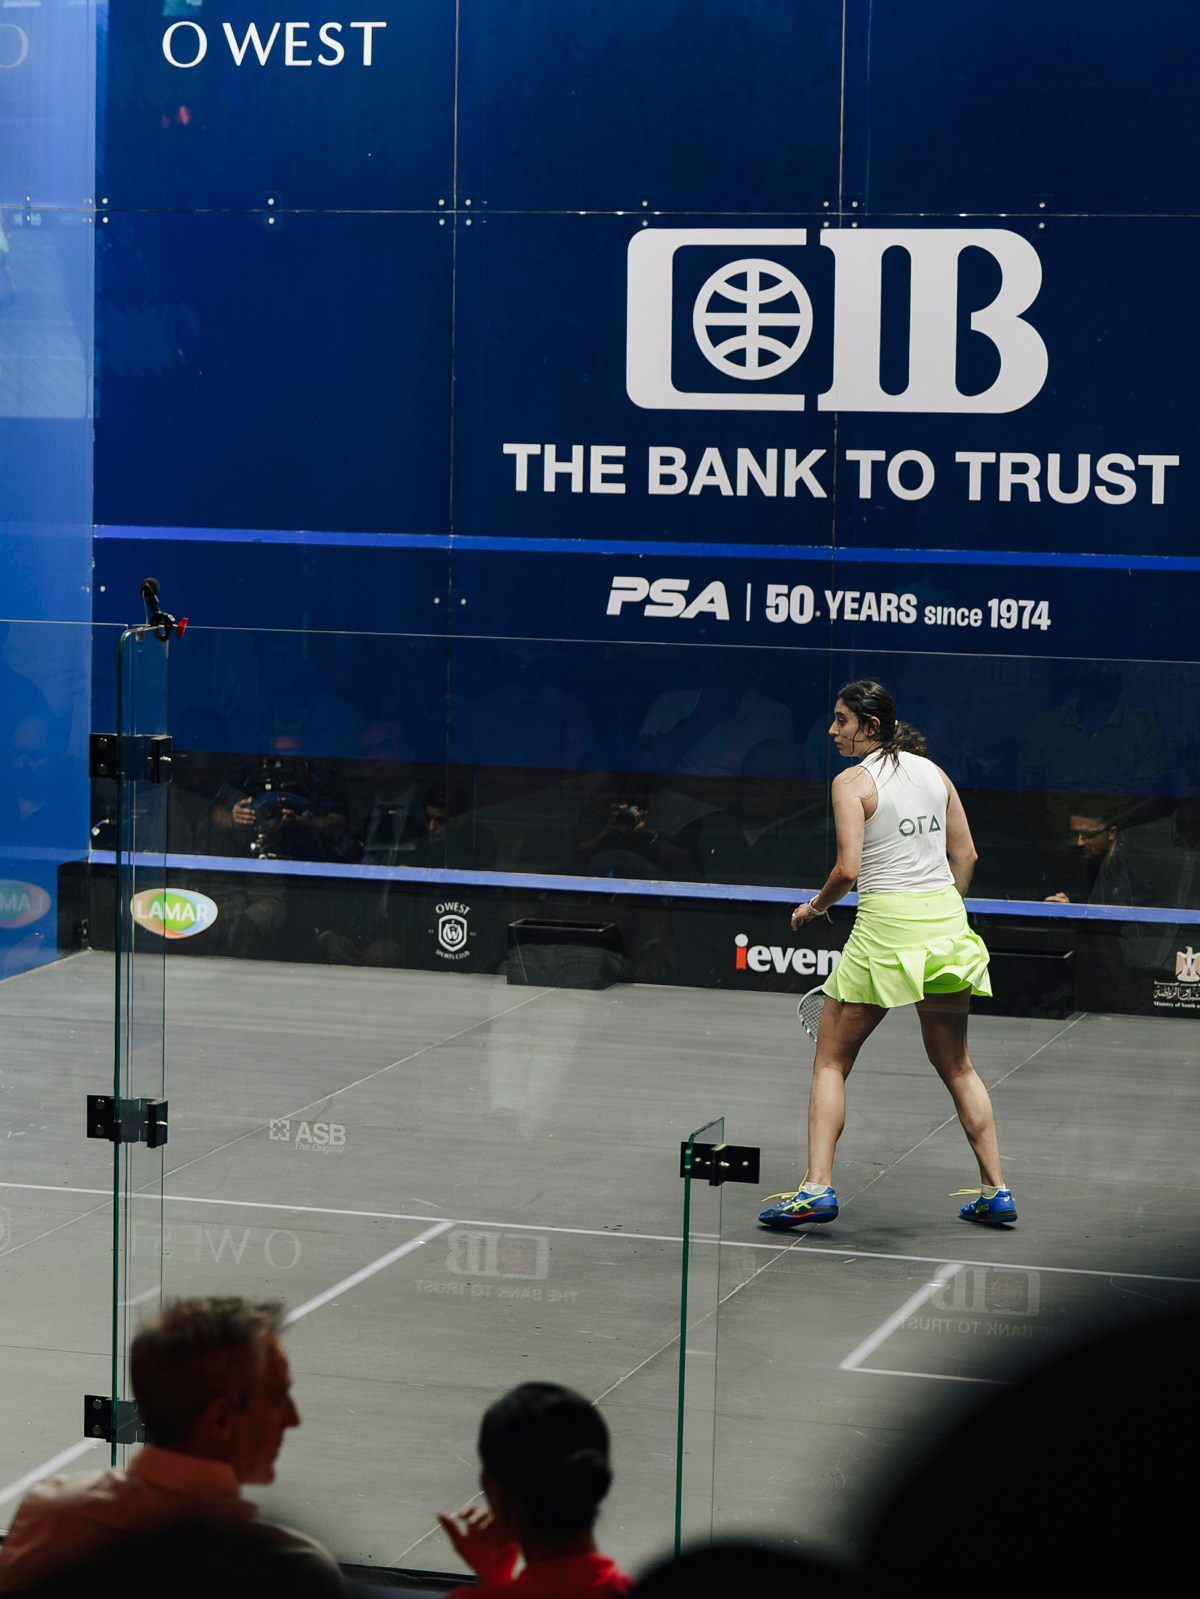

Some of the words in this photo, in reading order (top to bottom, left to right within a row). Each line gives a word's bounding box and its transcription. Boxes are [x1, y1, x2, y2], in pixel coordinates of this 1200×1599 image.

[162, 20, 208, 68] O
[222, 21, 388, 67] WEST
[626, 228, 1049, 414] CIB
[502, 443, 627, 494] THE
[648, 446, 828, 498] BANK
[845, 449, 935, 501] TO
[954, 451, 1180, 505] TRUST
[606, 576, 731, 621] PSA
[765, 583, 815, 625] 50
[825, 590, 918, 624] YEARS
[924, 604, 982, 628] since
[987, 598, 1052, 631] 1974
[136, 899, 209, 923] LAMAR
[734, 933, 842, 976] ieven
[295, 1121, 346, 1146] ASB
[295, 1142, 310, 1151] The
[312, 1143, 345, 1155] Original
